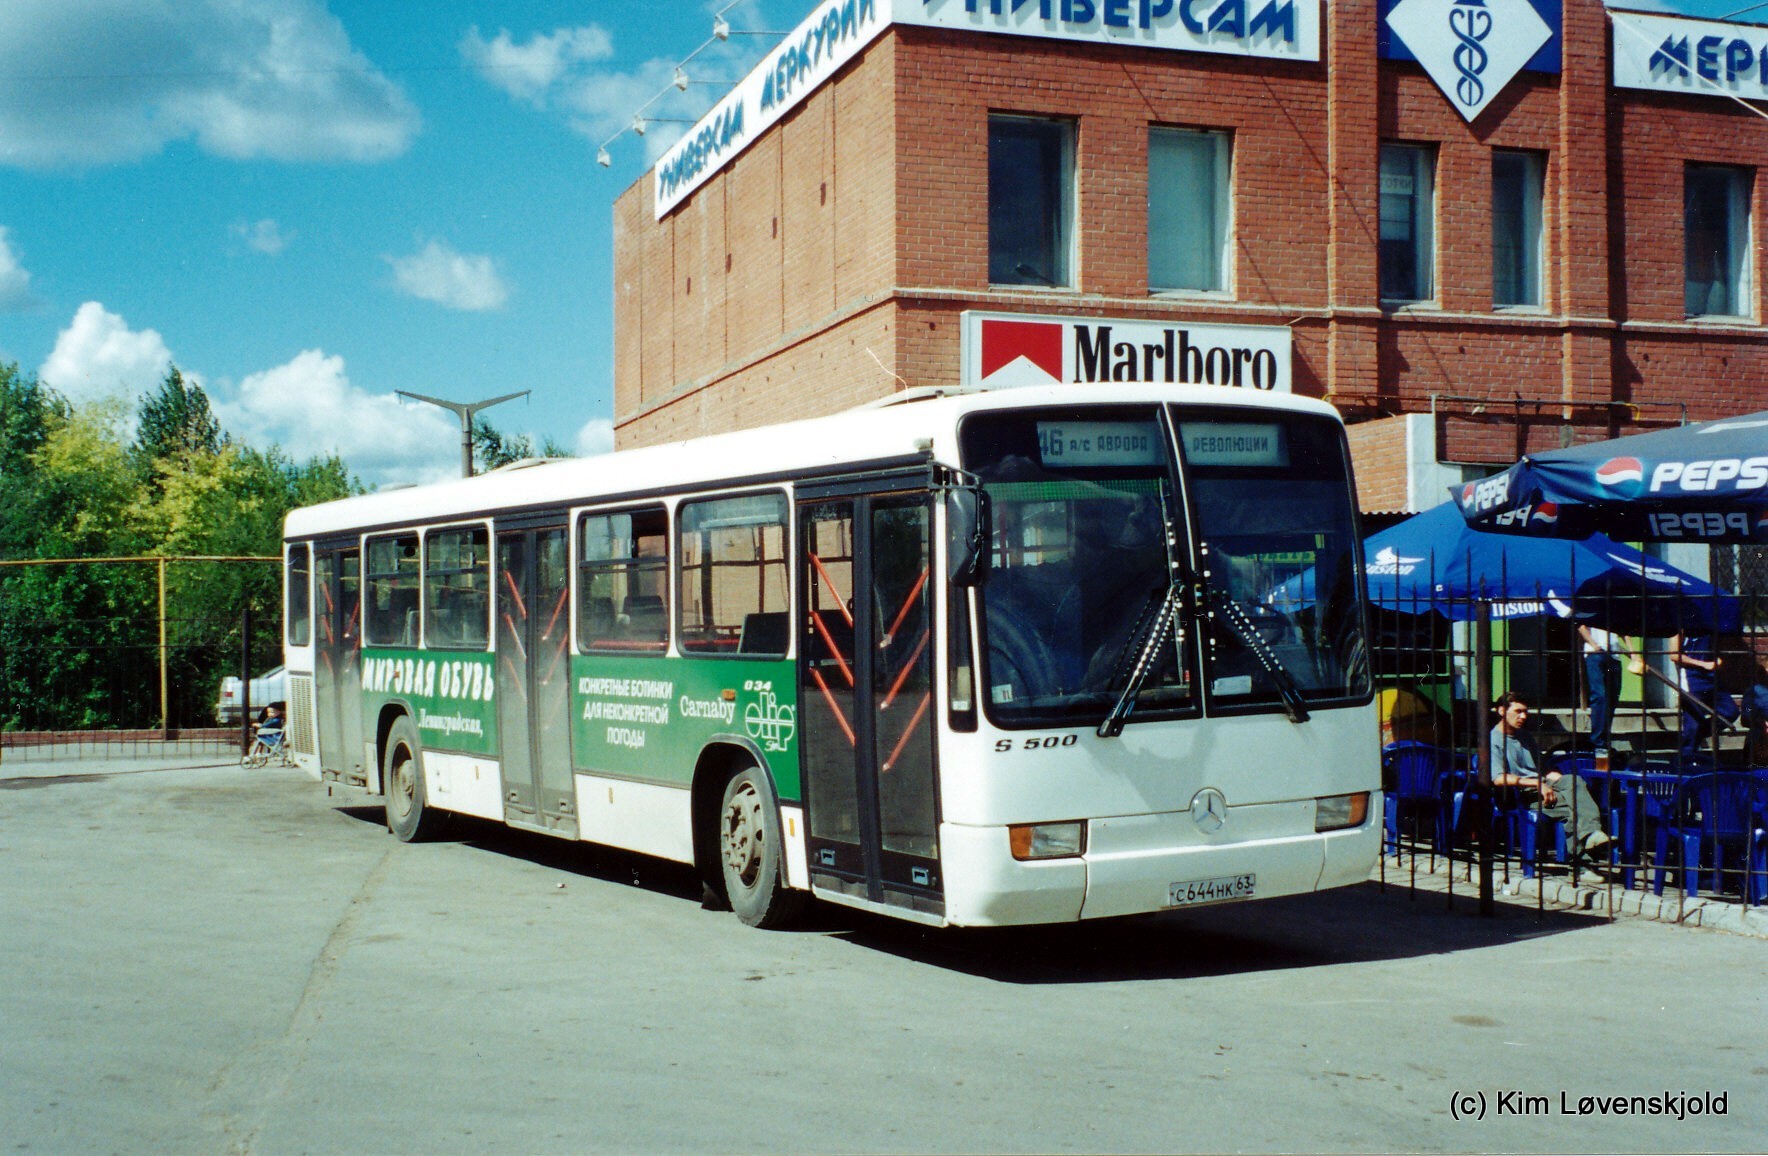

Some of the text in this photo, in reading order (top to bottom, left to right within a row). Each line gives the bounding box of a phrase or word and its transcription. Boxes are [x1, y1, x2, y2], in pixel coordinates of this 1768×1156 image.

[922, 0, 1294, 43] ВЕРСАМ
[1073, 325, 1277, 392] Marlboro
[1039, 429, 1064, 456] 46
[1192, 436, 1269, 453] РЕВОЛЮЦИИ
[1649, 456, 1768, 492] PEPS
[1475, 473, 1510, 513] PEPSI
[362, 657, 494, 701] МИРОВАЯ ОБУВЬ
[579, 677, 673, 699] КОНКРЕТНЫЕ БОТИНКИ
[744, 680, 772, 691] 034
[583, 701, 669, 724] ДЛЯ НЕКОНКРЕТНОЙ
[680, 695, 736, 725] Carnaby
[606, 727, 646, 749] ПОГОДЫ
[994, 734, 1078, 752] S 500
